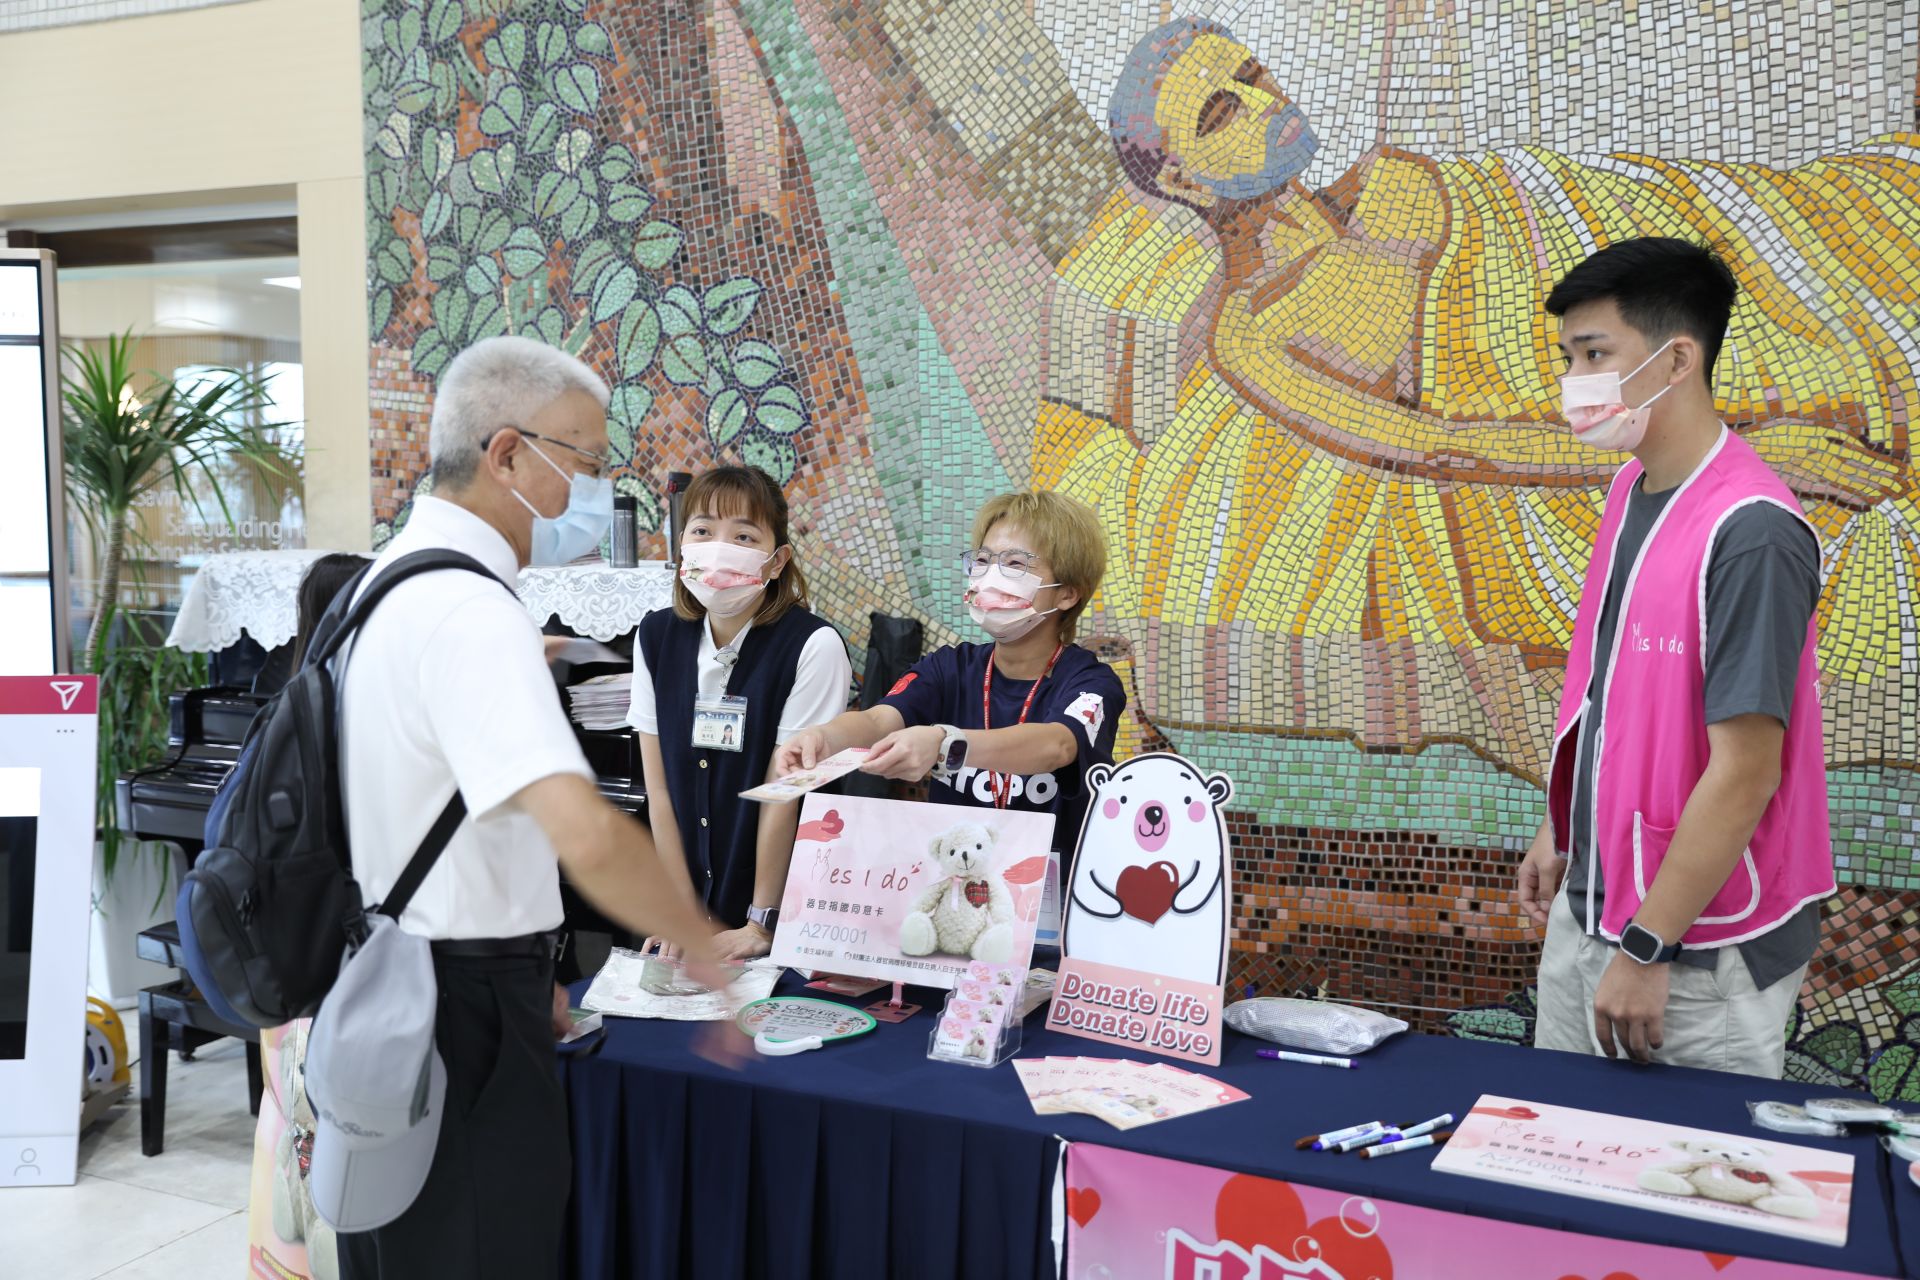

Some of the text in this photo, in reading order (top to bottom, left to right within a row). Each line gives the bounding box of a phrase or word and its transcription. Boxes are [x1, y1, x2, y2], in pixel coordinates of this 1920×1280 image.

[1668, 634, 1684, 655] do
[864, 869, 871, 886] I
[881, 868, 908, 891] do
[806, 898, 885, 917] 器官捐贈同意卡
[800, 923, 868, 945] A270001
[1061, 971, 1208, 1024] Donate life
[1051, 999, 1212, 1054] Donate love
[1602, 1145, 1642, 1159] do
